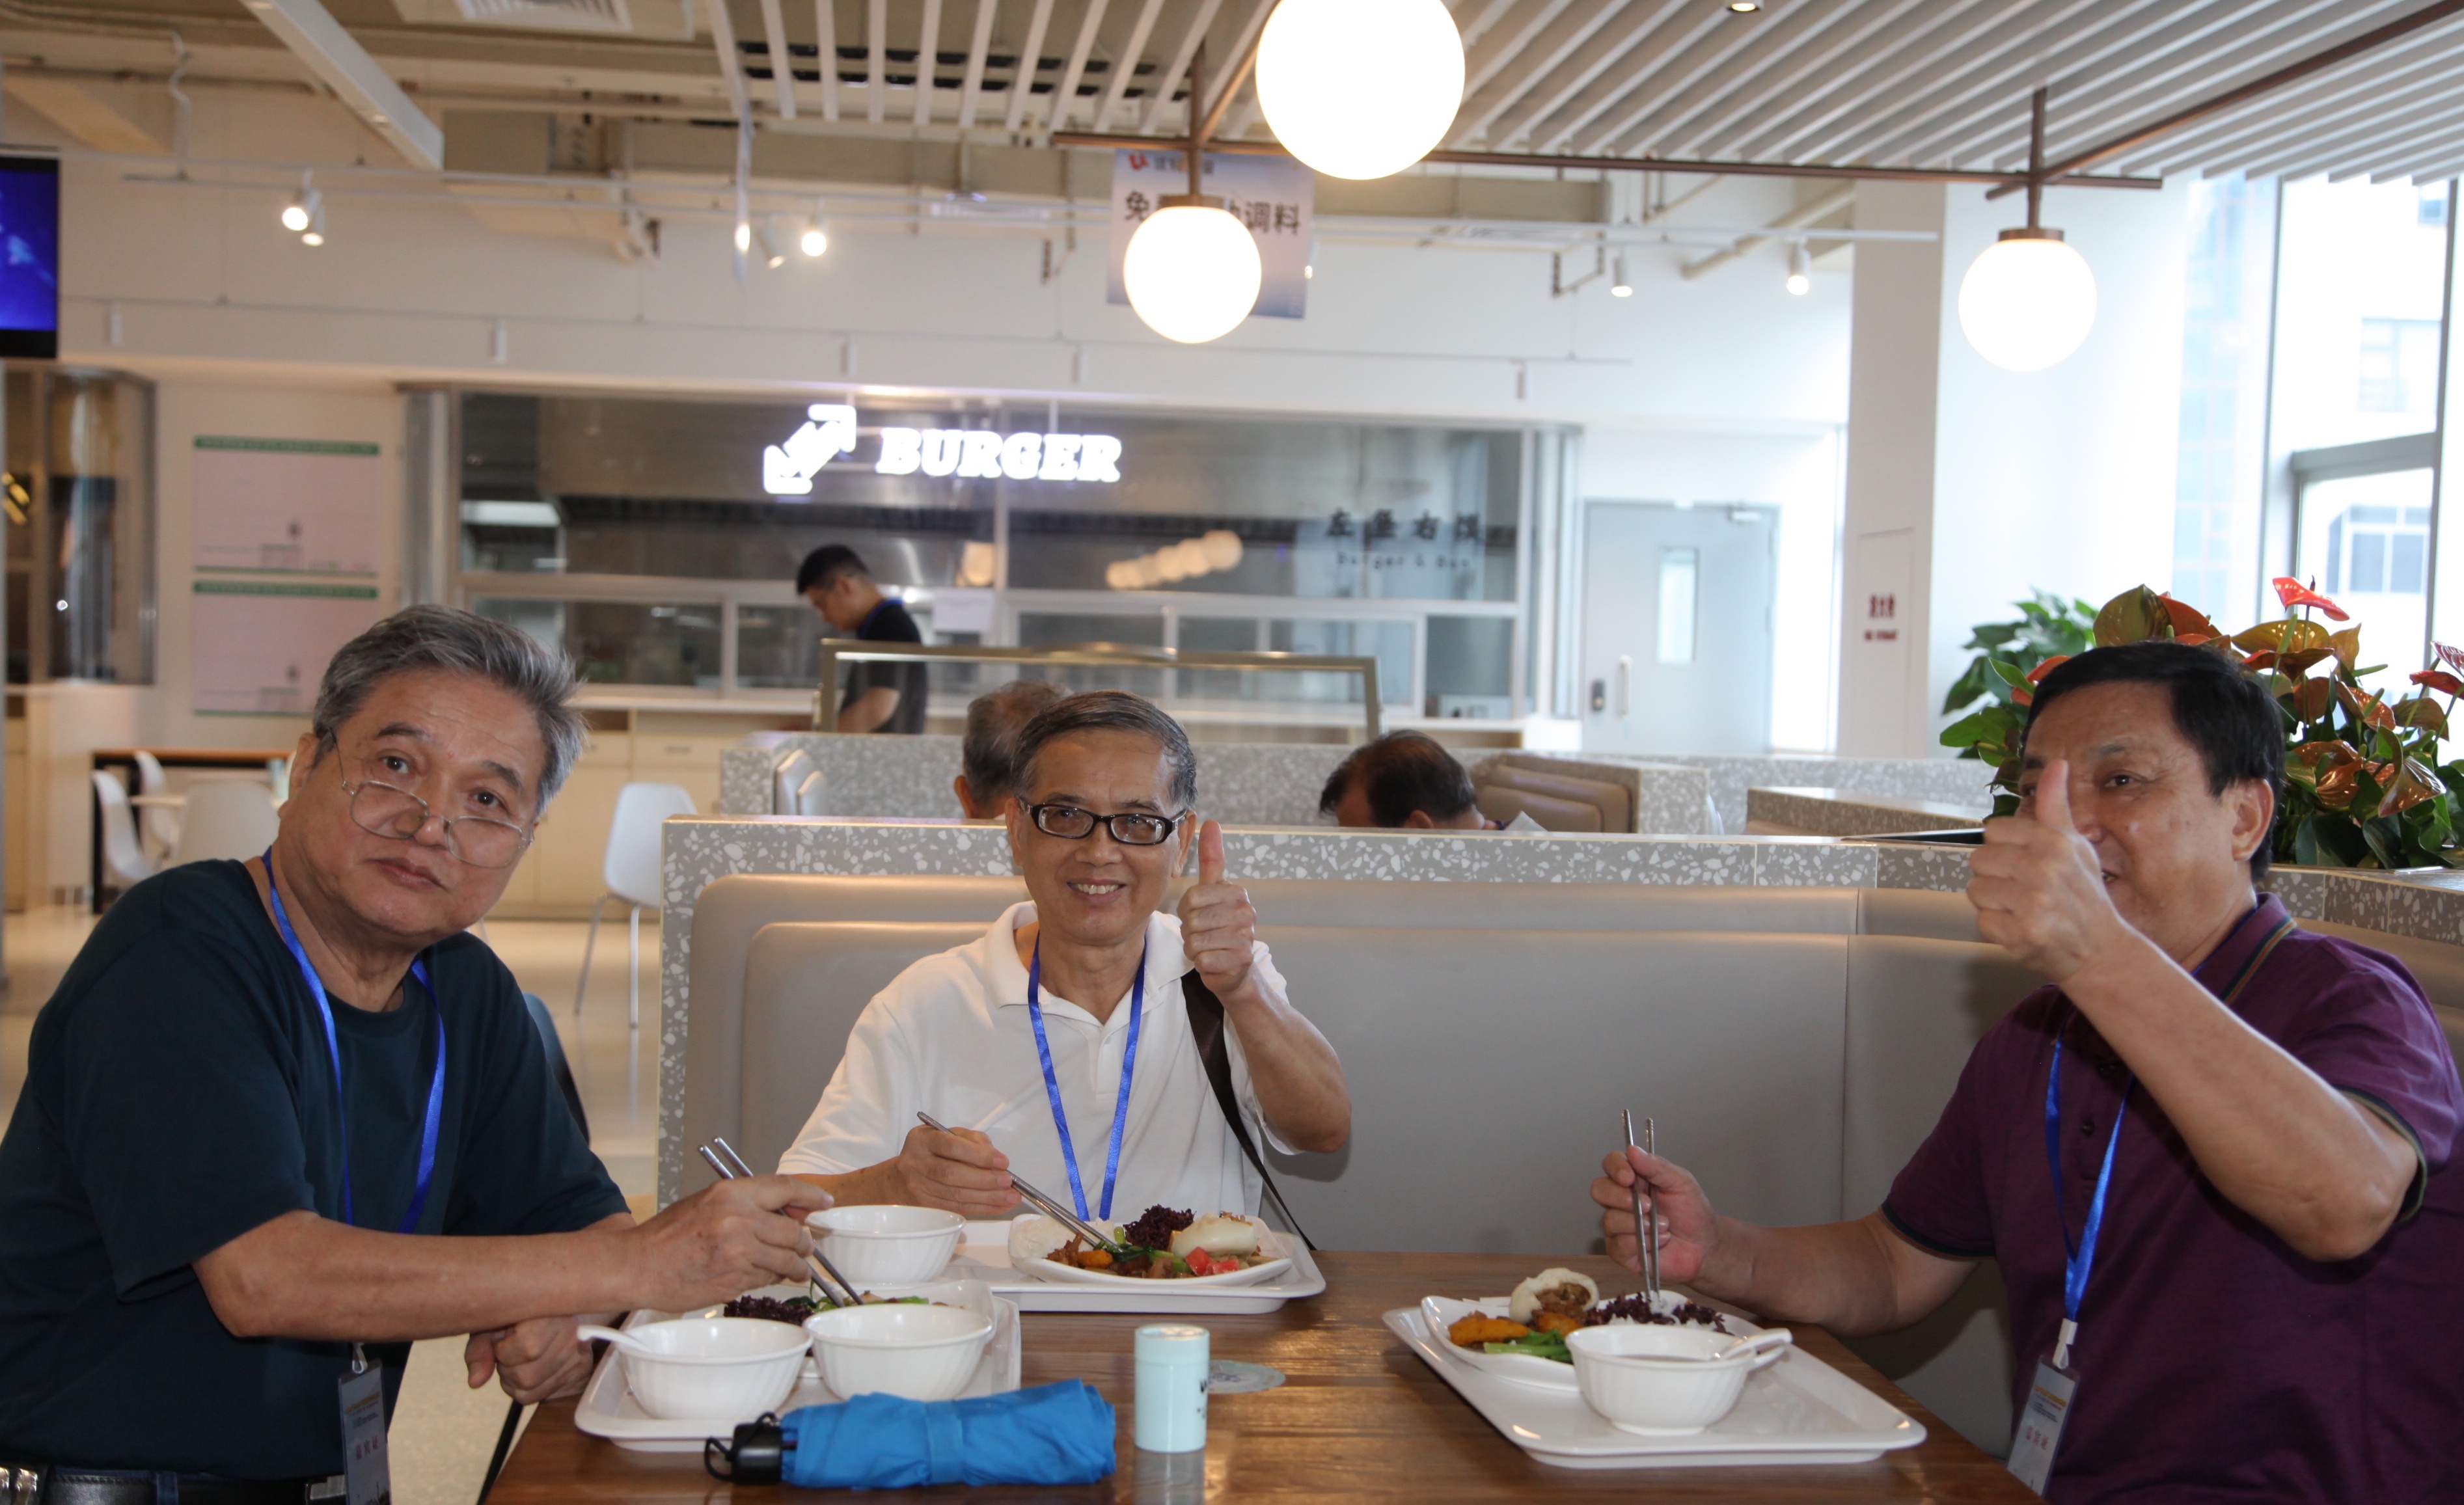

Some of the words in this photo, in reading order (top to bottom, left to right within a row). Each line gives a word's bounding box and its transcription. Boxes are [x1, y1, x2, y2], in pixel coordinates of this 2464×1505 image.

[1125, 190, 1300, 235] 免调料
[875, 427, 1121, 482] BURGER
[1338, 554, 1404, 570] Buger
